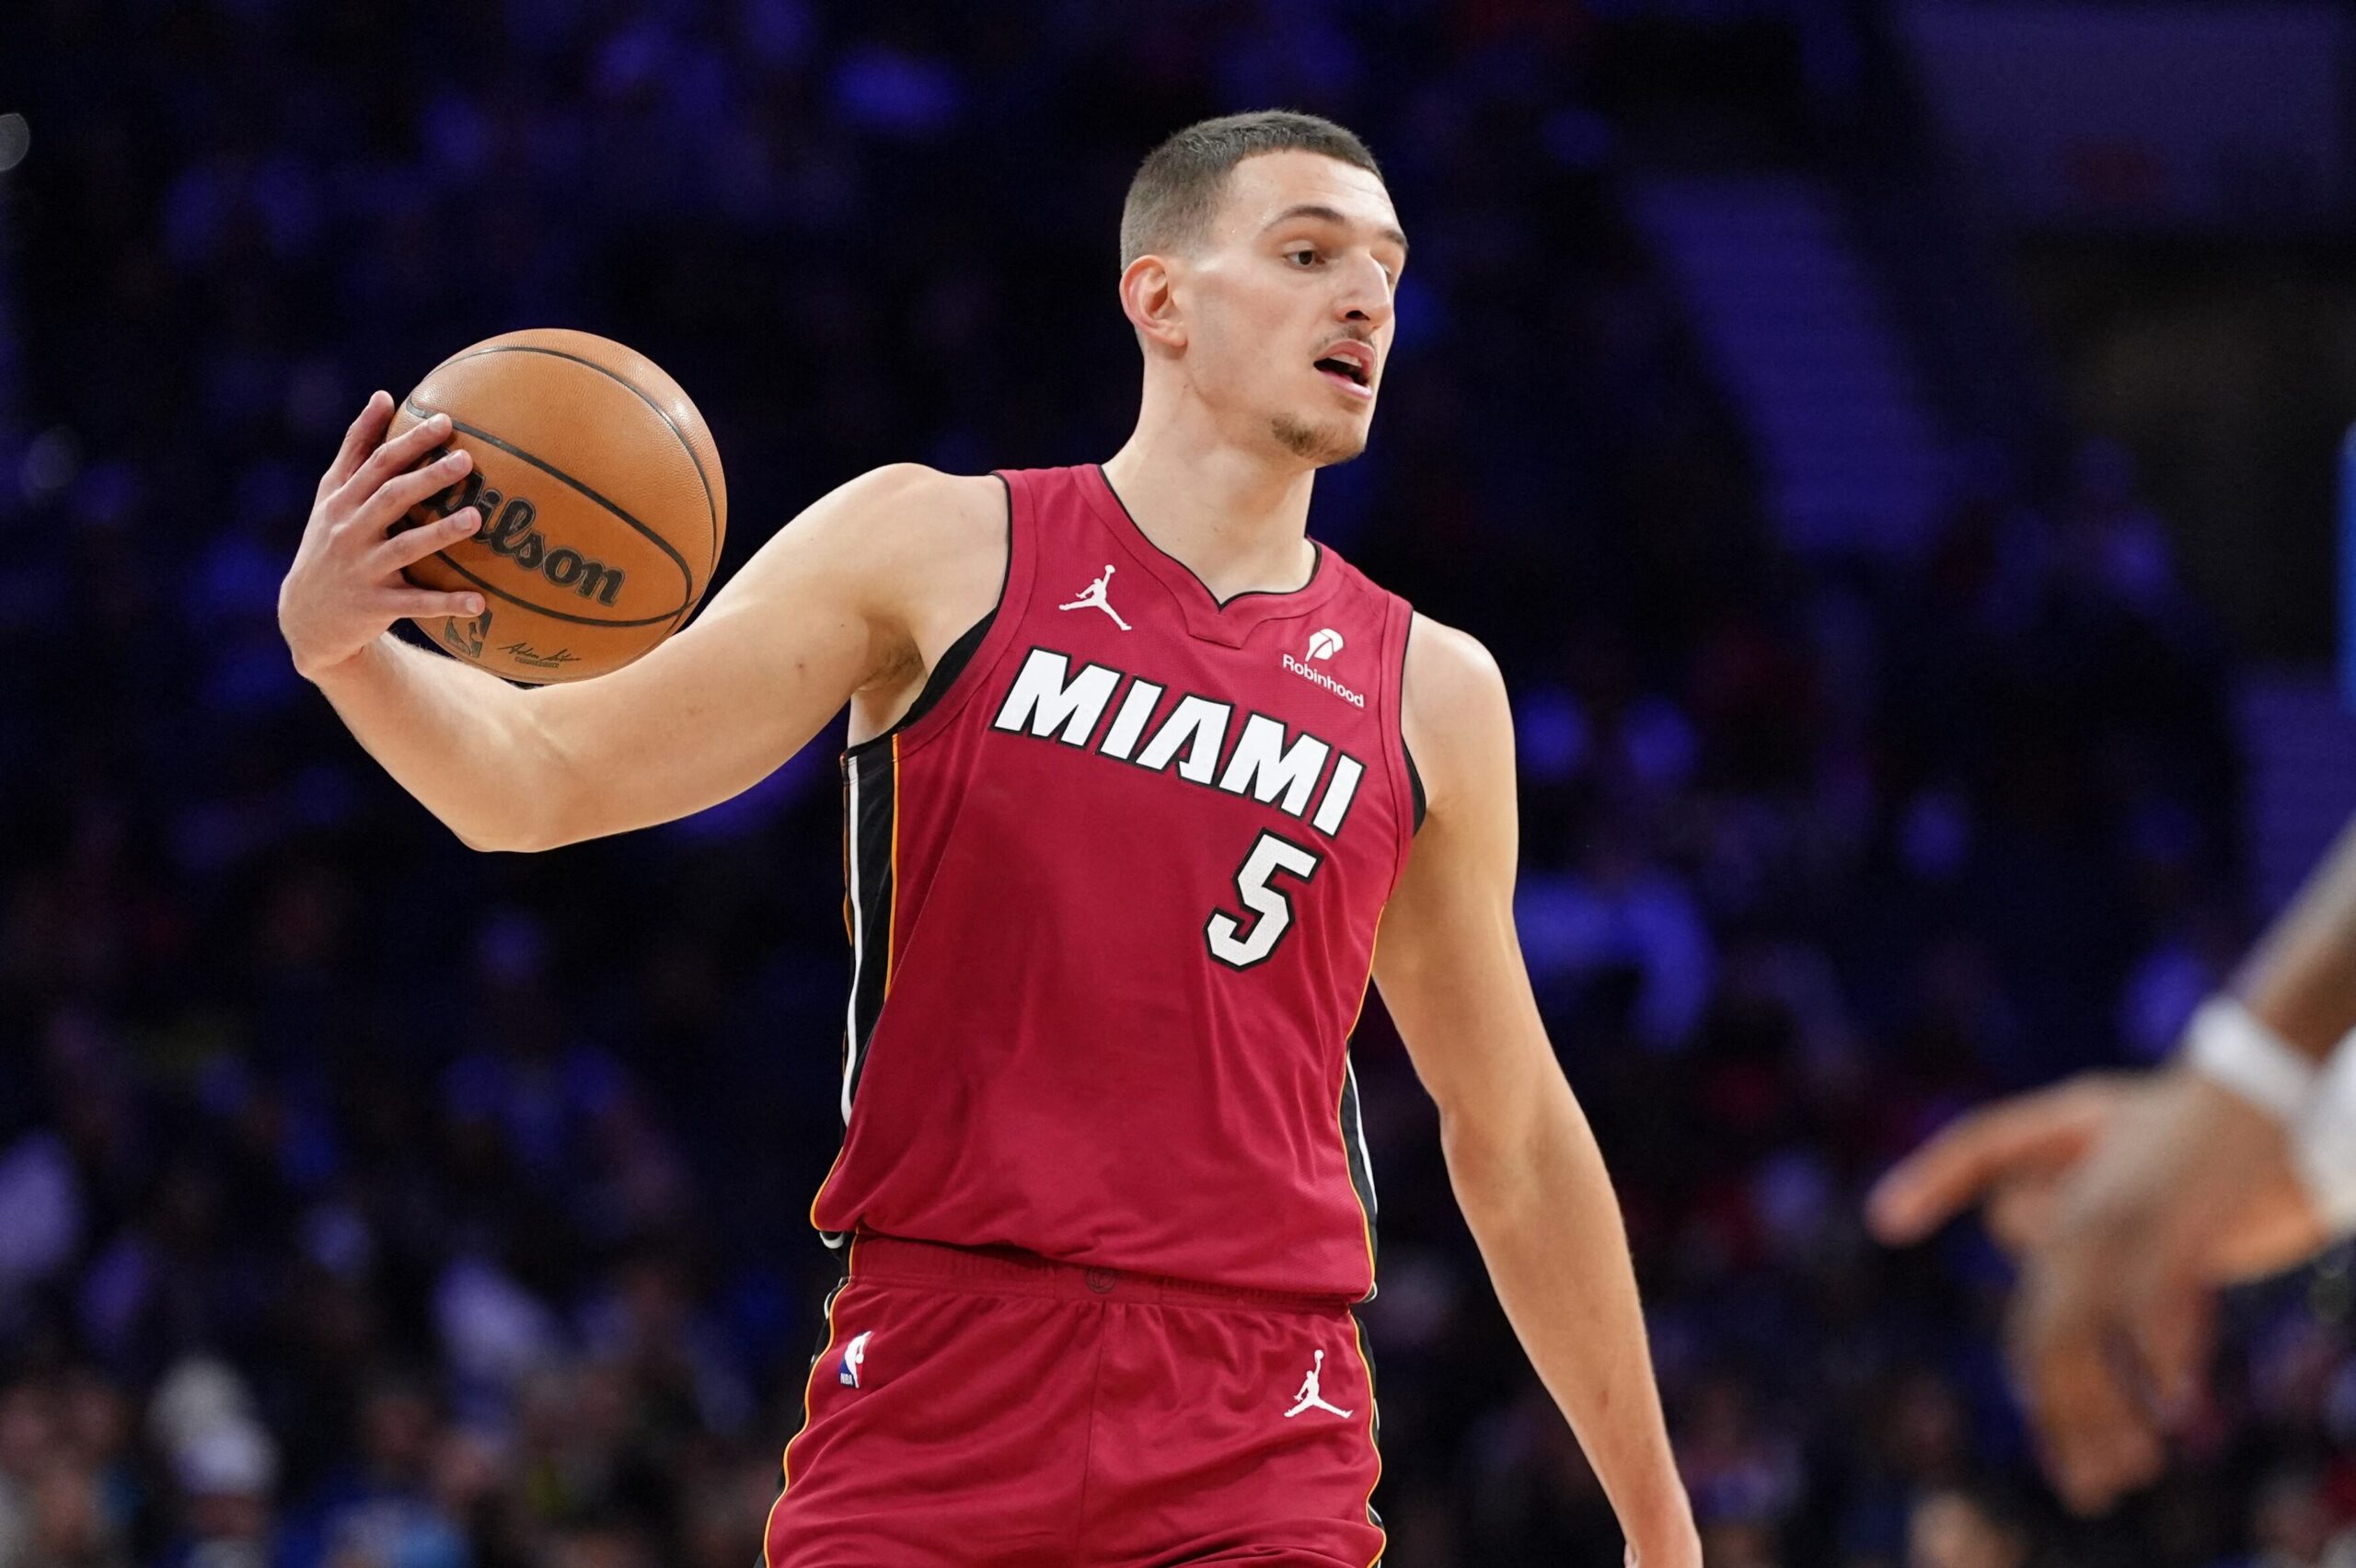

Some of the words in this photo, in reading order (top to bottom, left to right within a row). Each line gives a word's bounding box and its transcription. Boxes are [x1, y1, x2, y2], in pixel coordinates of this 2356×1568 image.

[1282, 653, 1365, 708] Robinhood
[991, 646, 1367, 837] MIAMI
[1203, 828, 1322, 971] 5
[840, 1372, 854, 1386] NBA
